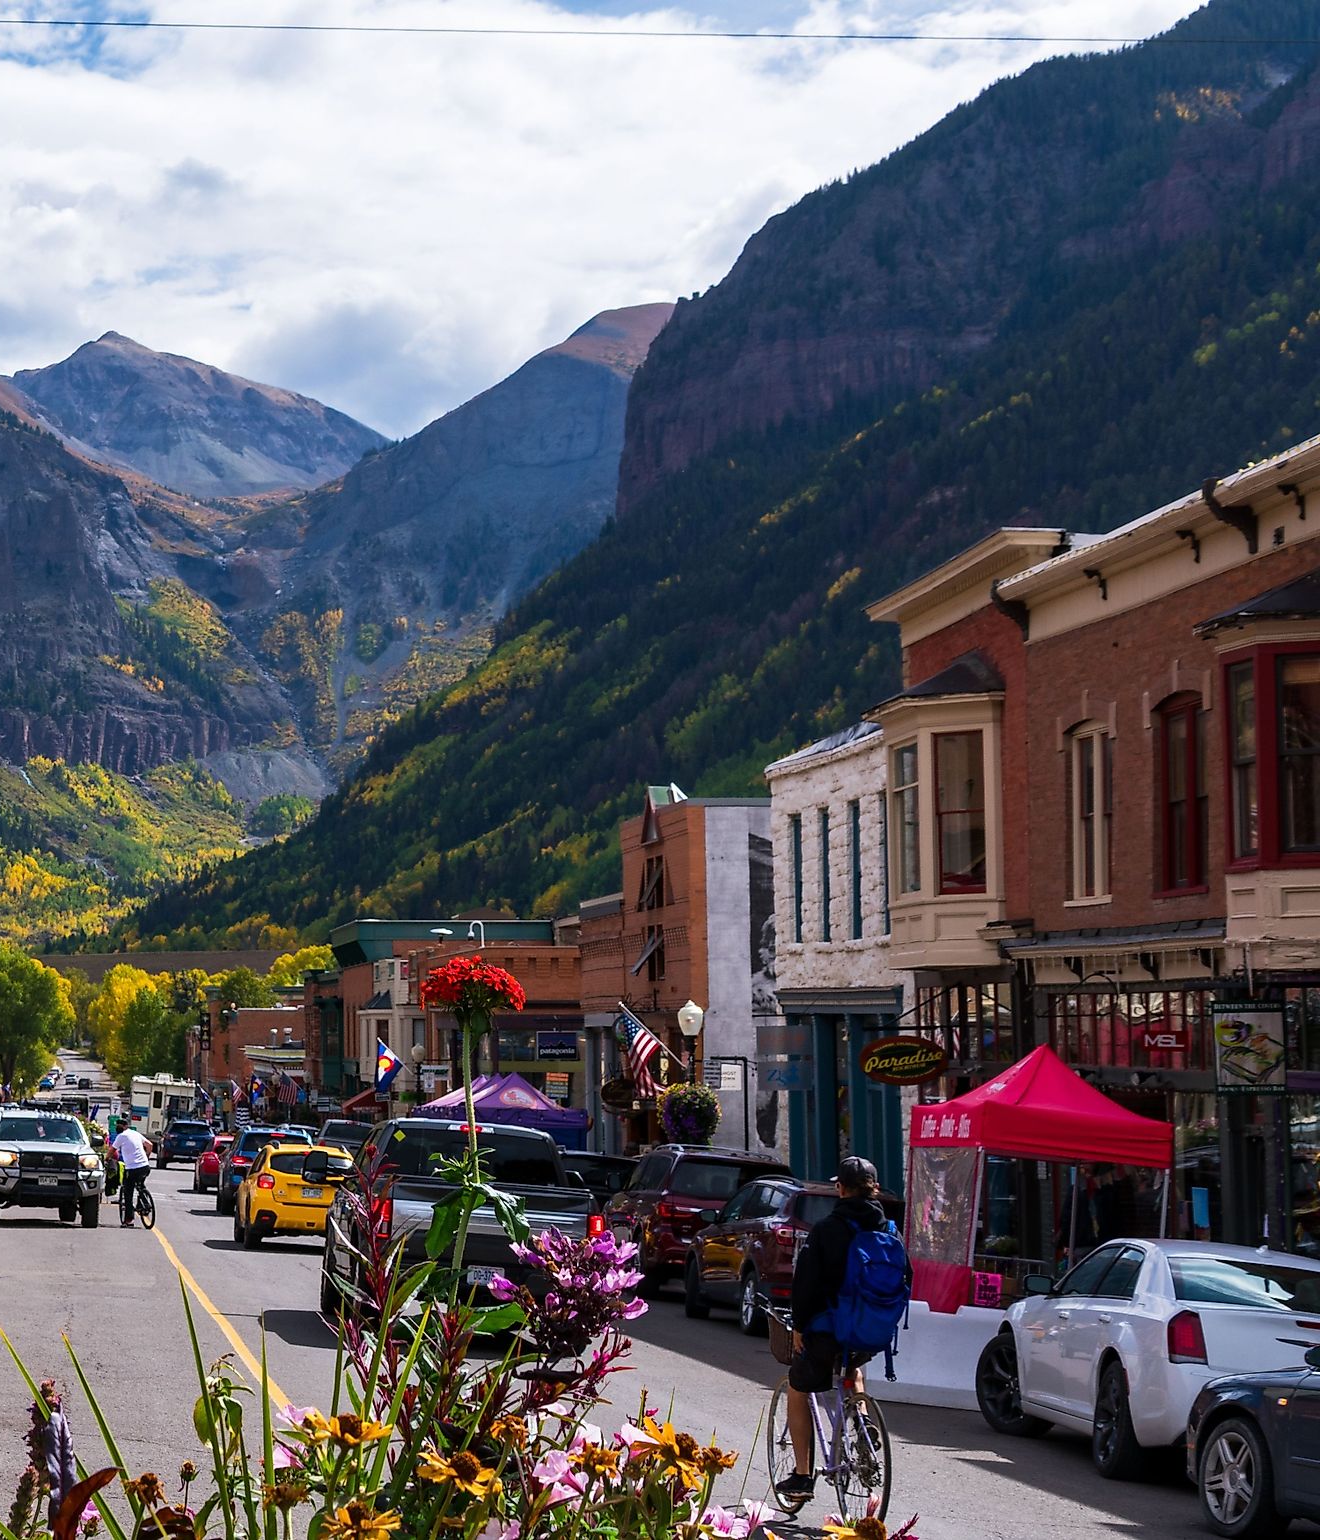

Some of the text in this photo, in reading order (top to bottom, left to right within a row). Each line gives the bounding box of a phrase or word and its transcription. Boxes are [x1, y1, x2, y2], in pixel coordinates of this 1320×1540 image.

[1144, 1034, 1184, 1047] MSL
[540, 1047, 575, 1056] patagonia
[864, 1049, 943, 1073] Paradise
